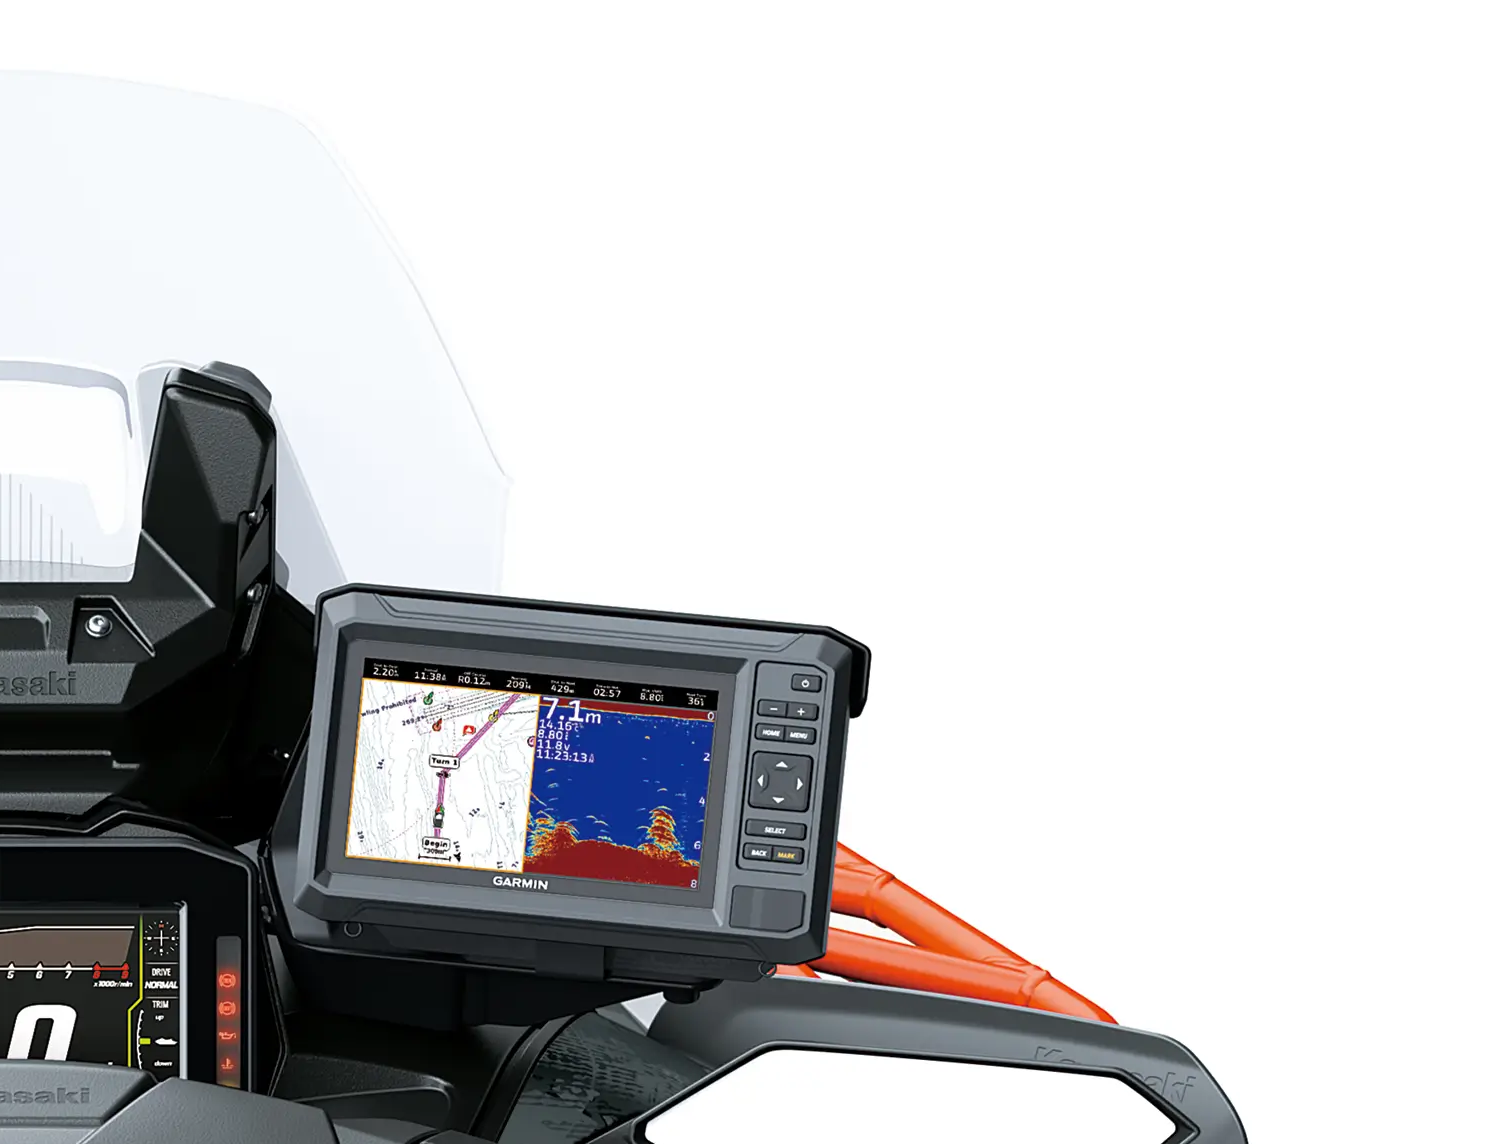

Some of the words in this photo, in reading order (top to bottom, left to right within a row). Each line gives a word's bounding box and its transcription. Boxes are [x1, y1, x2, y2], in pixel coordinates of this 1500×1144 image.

[708, 712, 714, 720] 0
[762, 729, 780, 737] HOME
[790, 732, 808, 740] MENU
[703, 752, 710, 762] 2
[432, 758, 450, 766] Turn
[698, 797, 706, 806] 4
[425, 840, 448, 849] Begin
[694, 841, 702, 850] 6
[752, 849, 768, 857] BACK
[778, 852, 796, 860] MARK
[492, 876, 548, 890] GARMIN
[690, 880, 698, 888] 8
[7, 970, 15, 979] 5
[65, 970, 72, 979] 7
[121, 970, 128, 979] 9
[152, 968, 171, 976] DRIVE
[144, 981, 178, 989] NORMAL
[152, 1000, 169, 1008] TRIM
